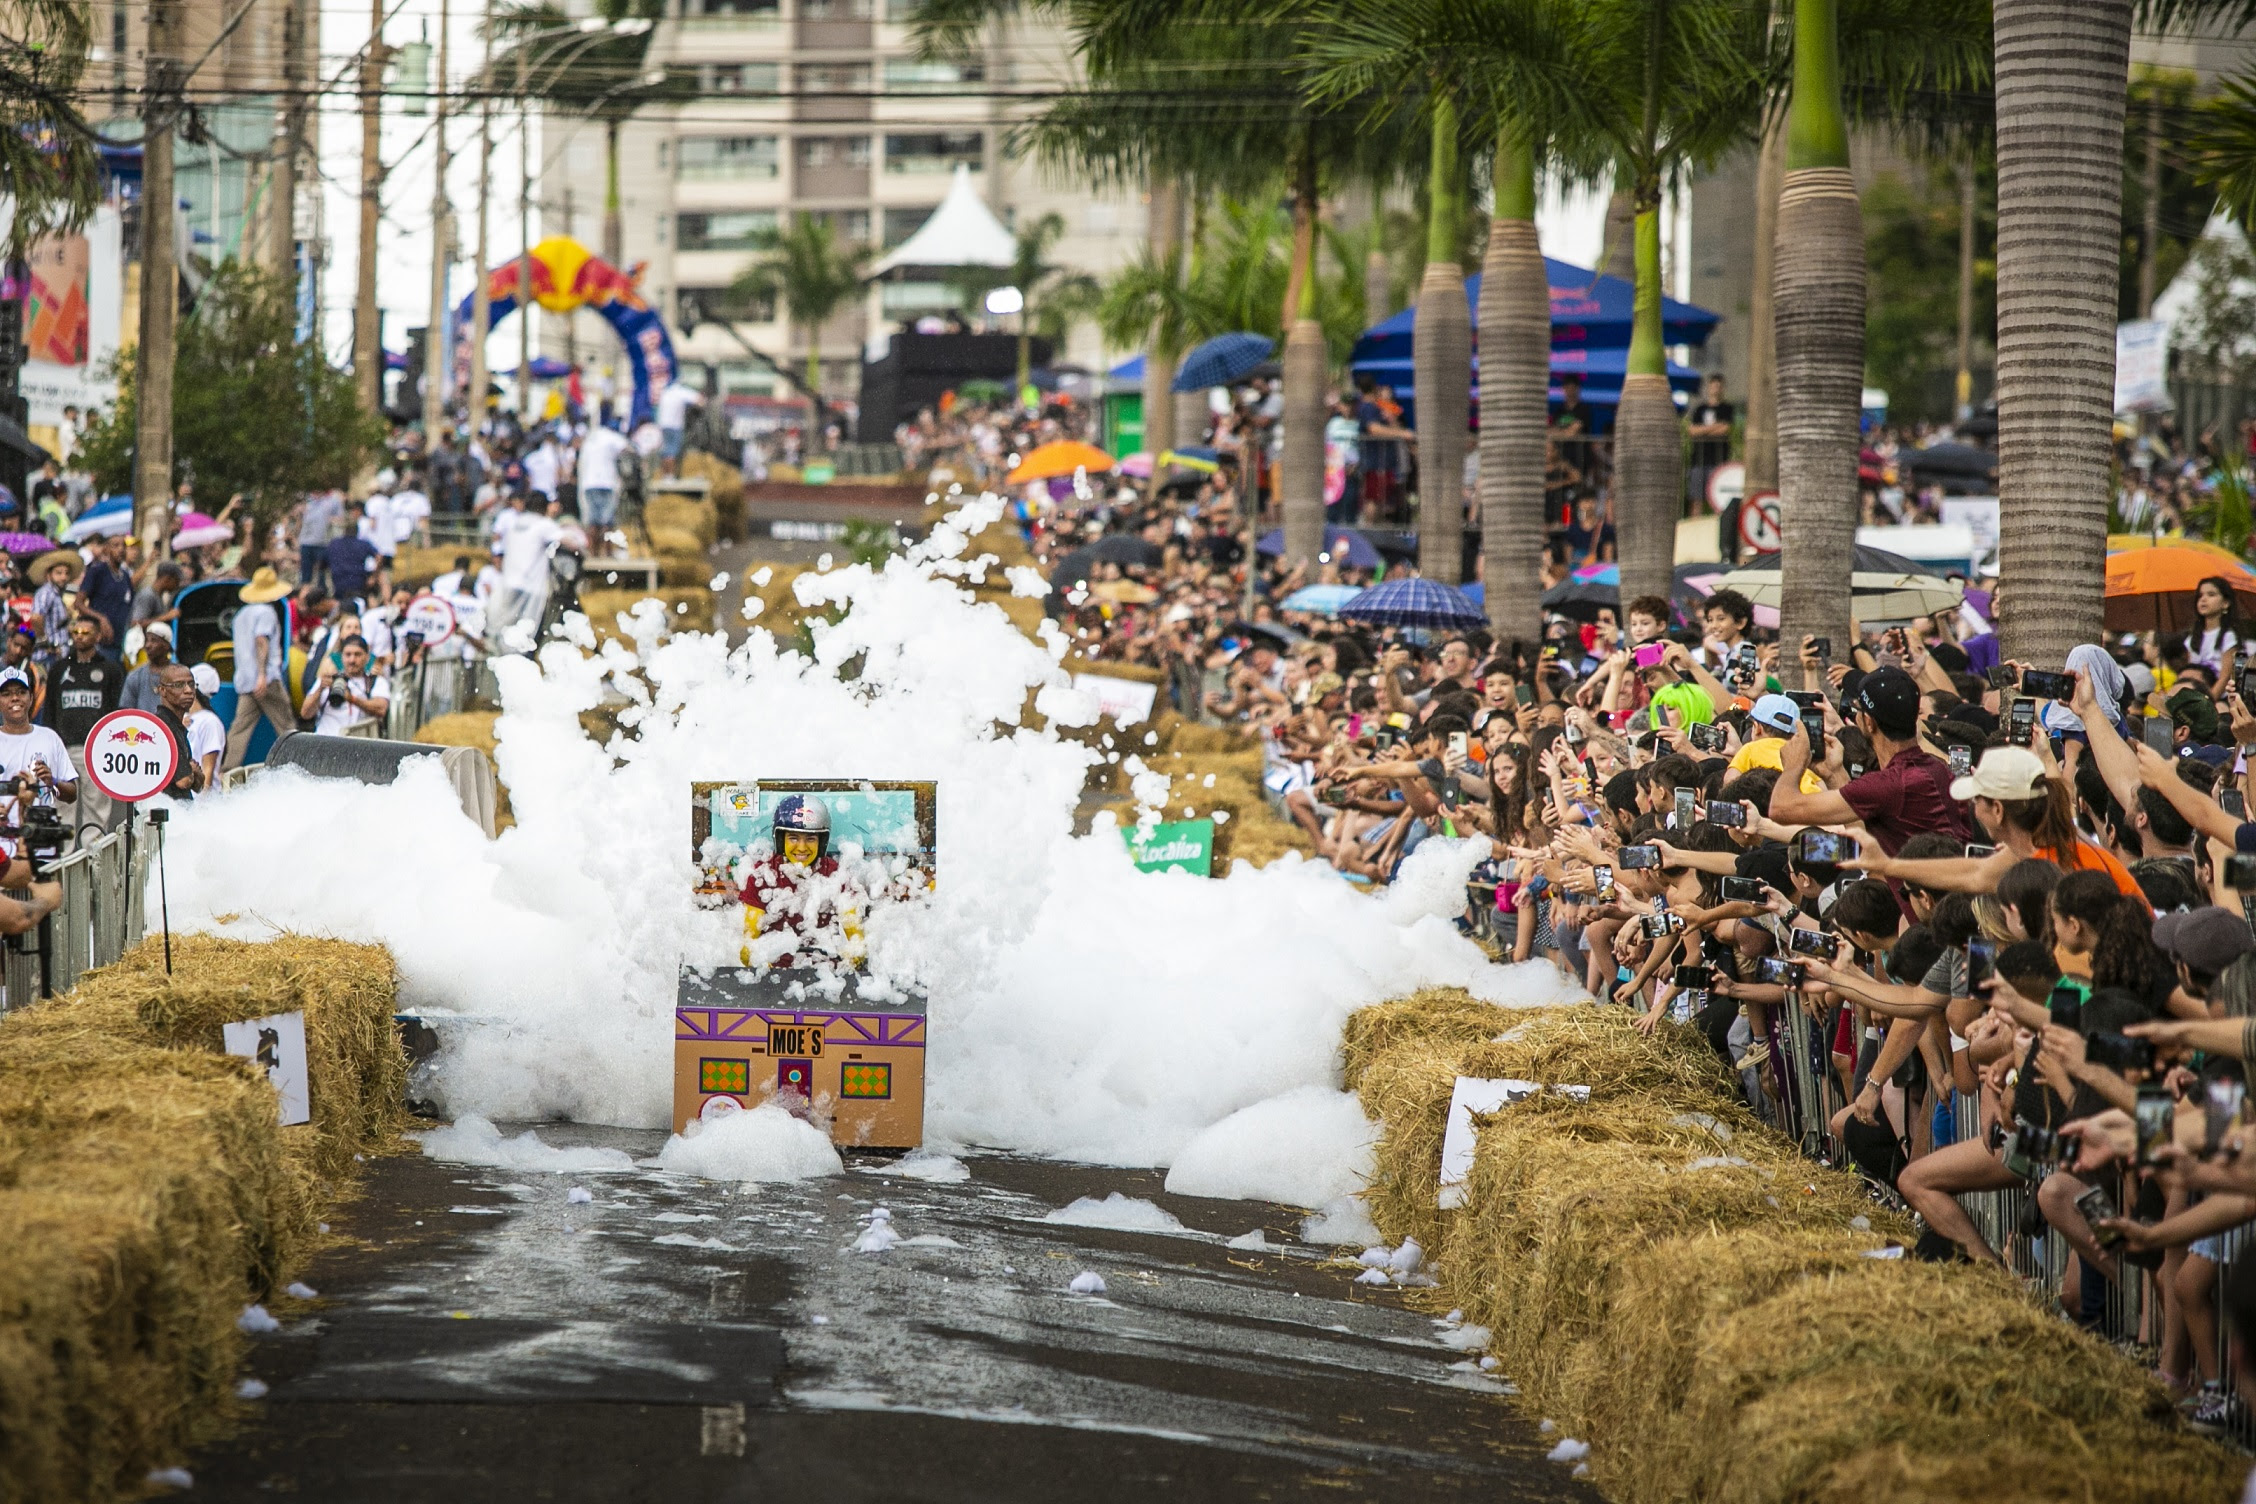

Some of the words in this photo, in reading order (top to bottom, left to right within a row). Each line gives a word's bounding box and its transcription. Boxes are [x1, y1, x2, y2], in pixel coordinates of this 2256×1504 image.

[62, 691, 101, 708] PARIS
[102, 752, 139, 775] 300
[144, 760, 161, 775] m
[1140, 833, 1202, 864] Localiza
